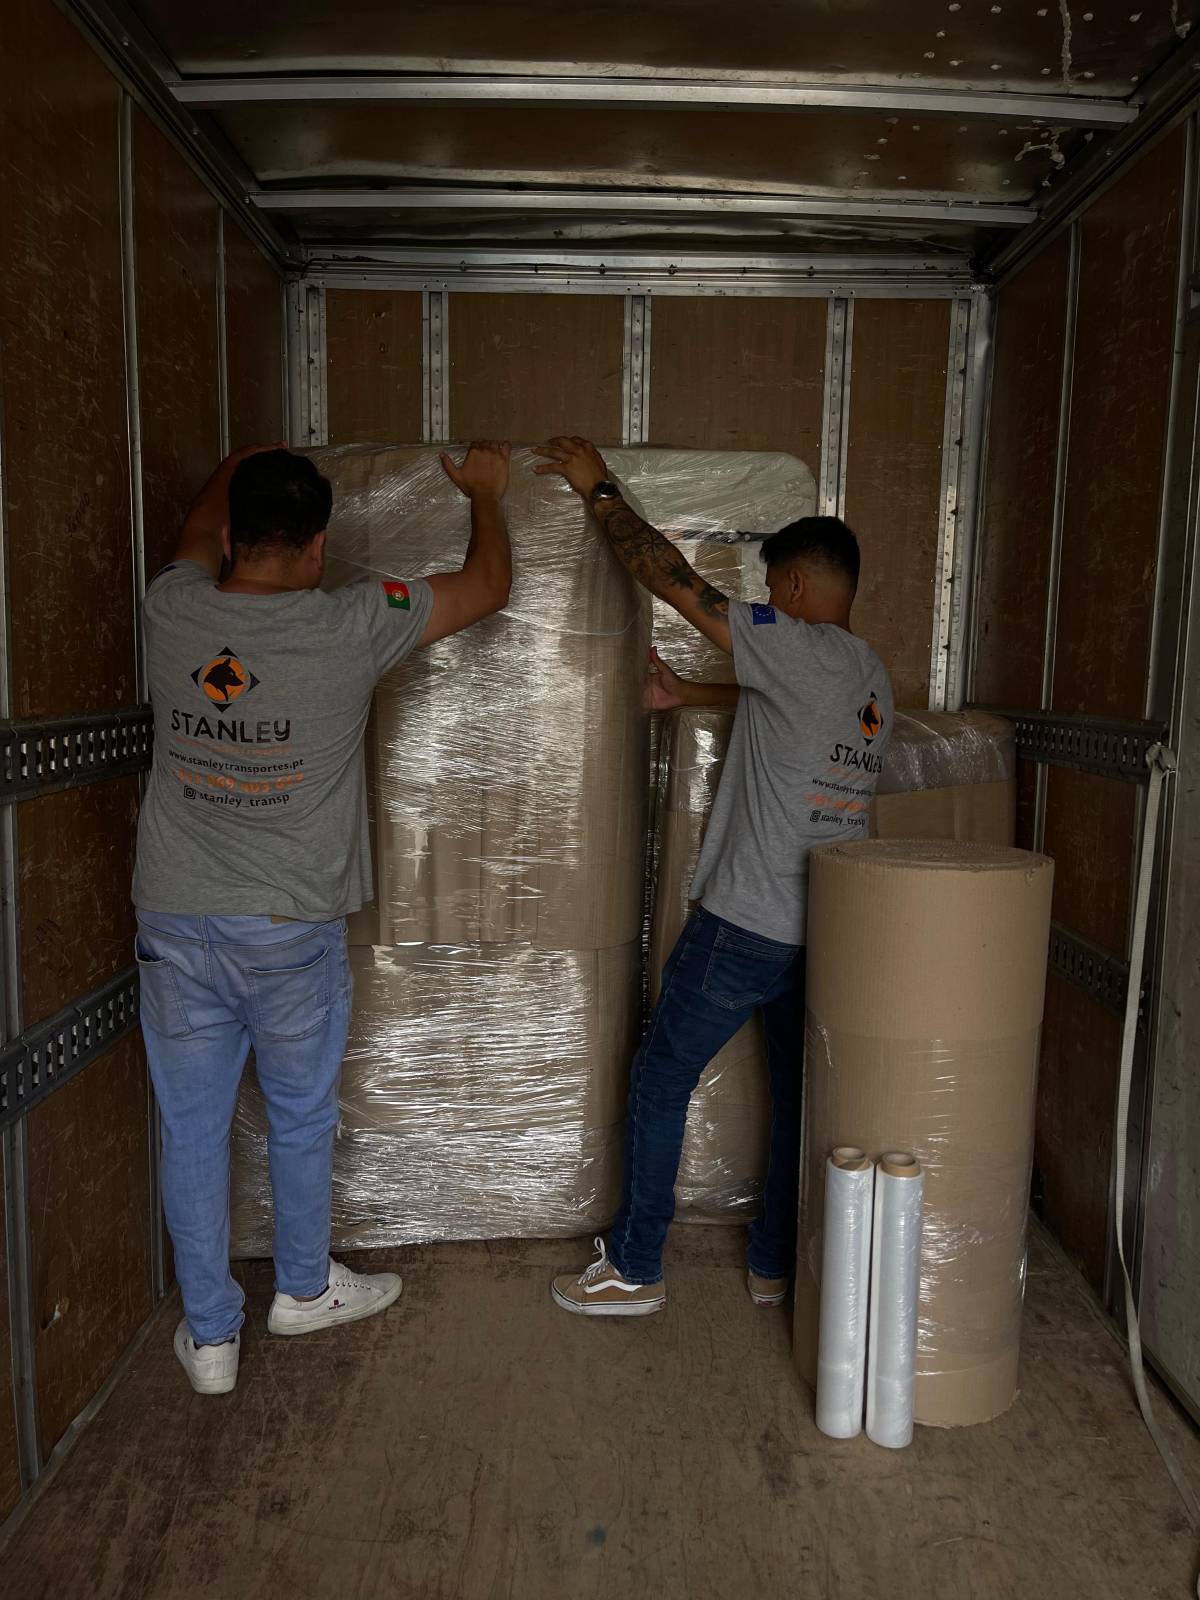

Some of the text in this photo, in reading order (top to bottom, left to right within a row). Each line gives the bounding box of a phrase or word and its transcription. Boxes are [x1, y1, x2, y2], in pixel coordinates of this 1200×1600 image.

[171, 709, 291, 743] STANLEY
[168, 748, 304, 774] www.stanleytransportes.pt
[200, 792, 290, 808] stanley_transp
